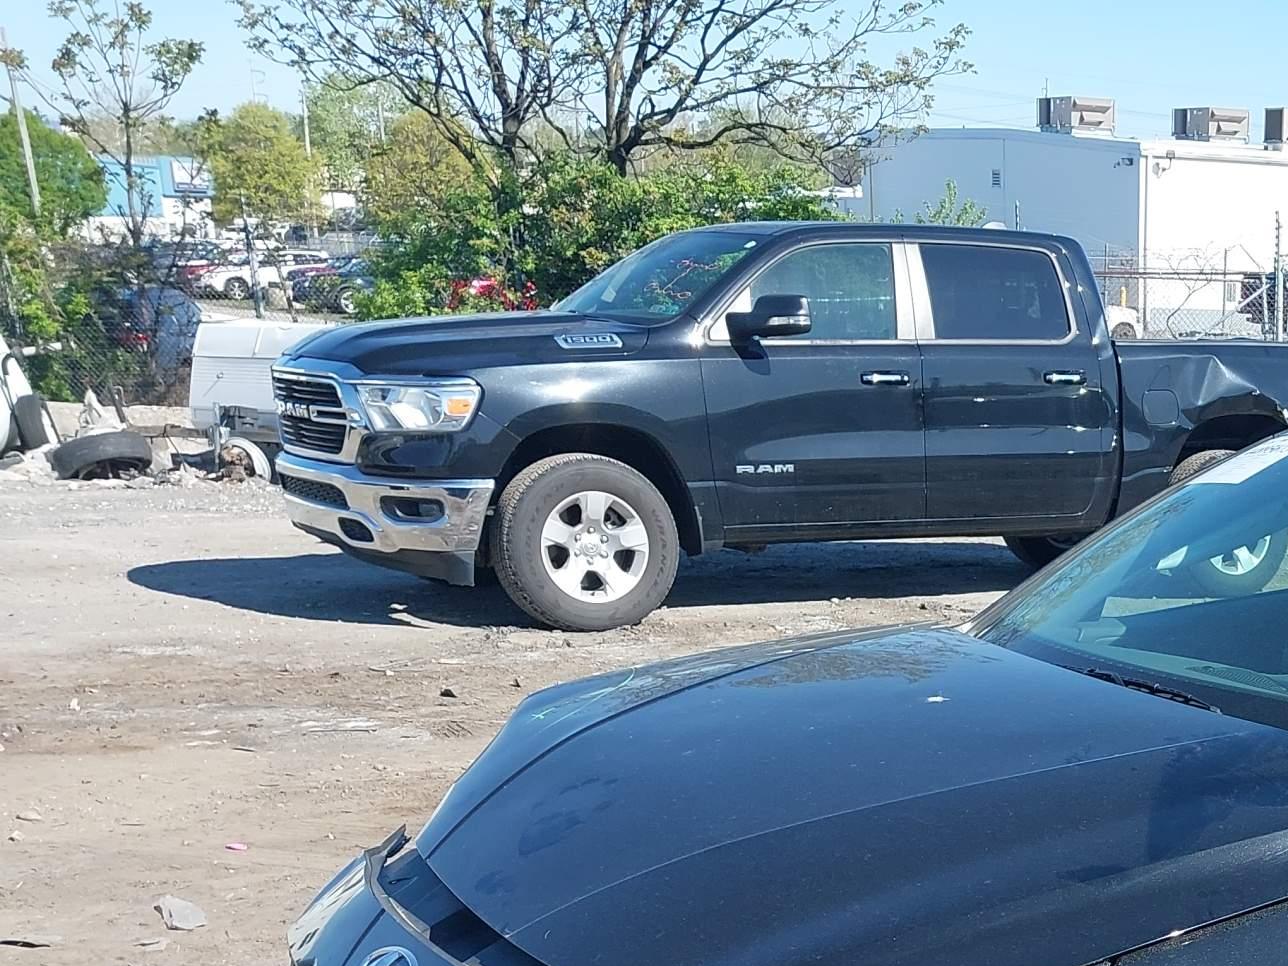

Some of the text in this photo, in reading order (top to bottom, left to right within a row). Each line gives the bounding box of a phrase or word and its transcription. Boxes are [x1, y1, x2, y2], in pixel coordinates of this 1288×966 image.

[565, 335, 612, 344] 1500
[277, 400, 310, 418] RAM
[735, 463, 795, 474] RAM
